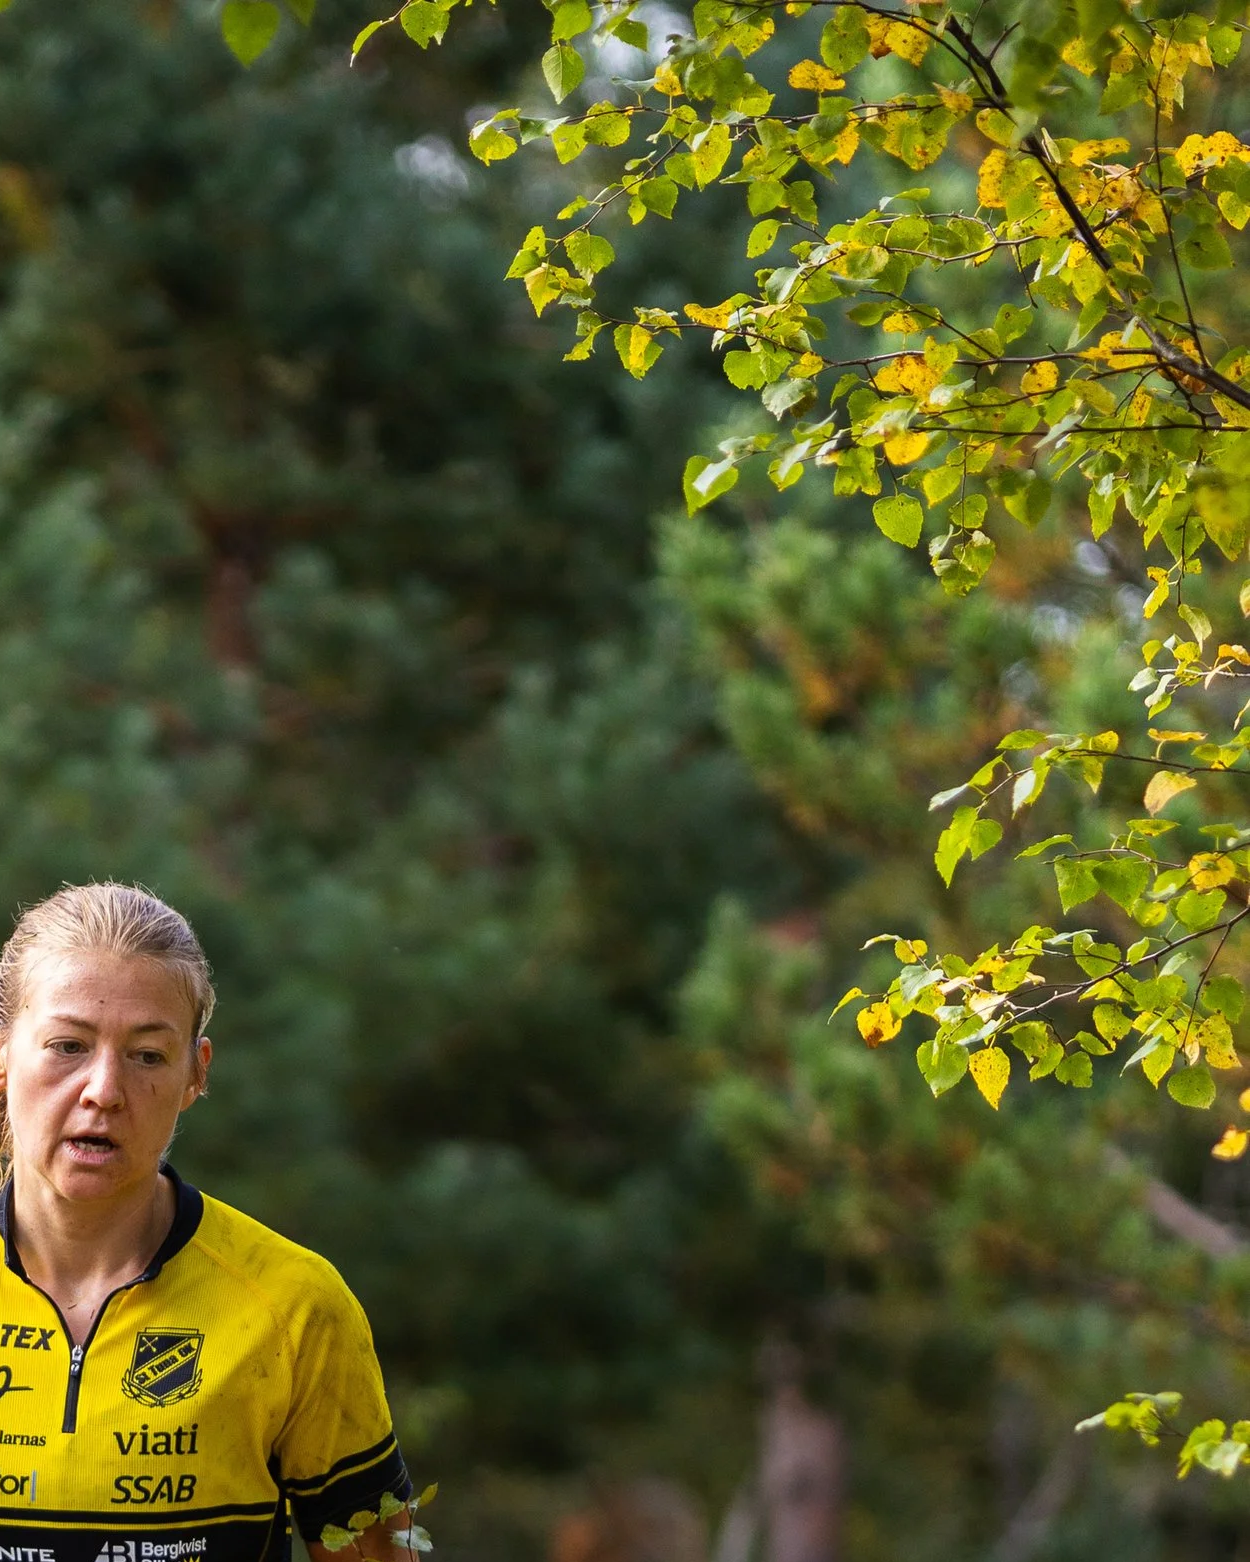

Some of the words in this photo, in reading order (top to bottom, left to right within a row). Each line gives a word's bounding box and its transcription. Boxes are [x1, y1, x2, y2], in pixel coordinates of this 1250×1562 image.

[113, 1423, 199, 1455] viati
[110, 1474, 197, 1504] SSAB
[141, 1537, 207, 1558] Bergkvist
